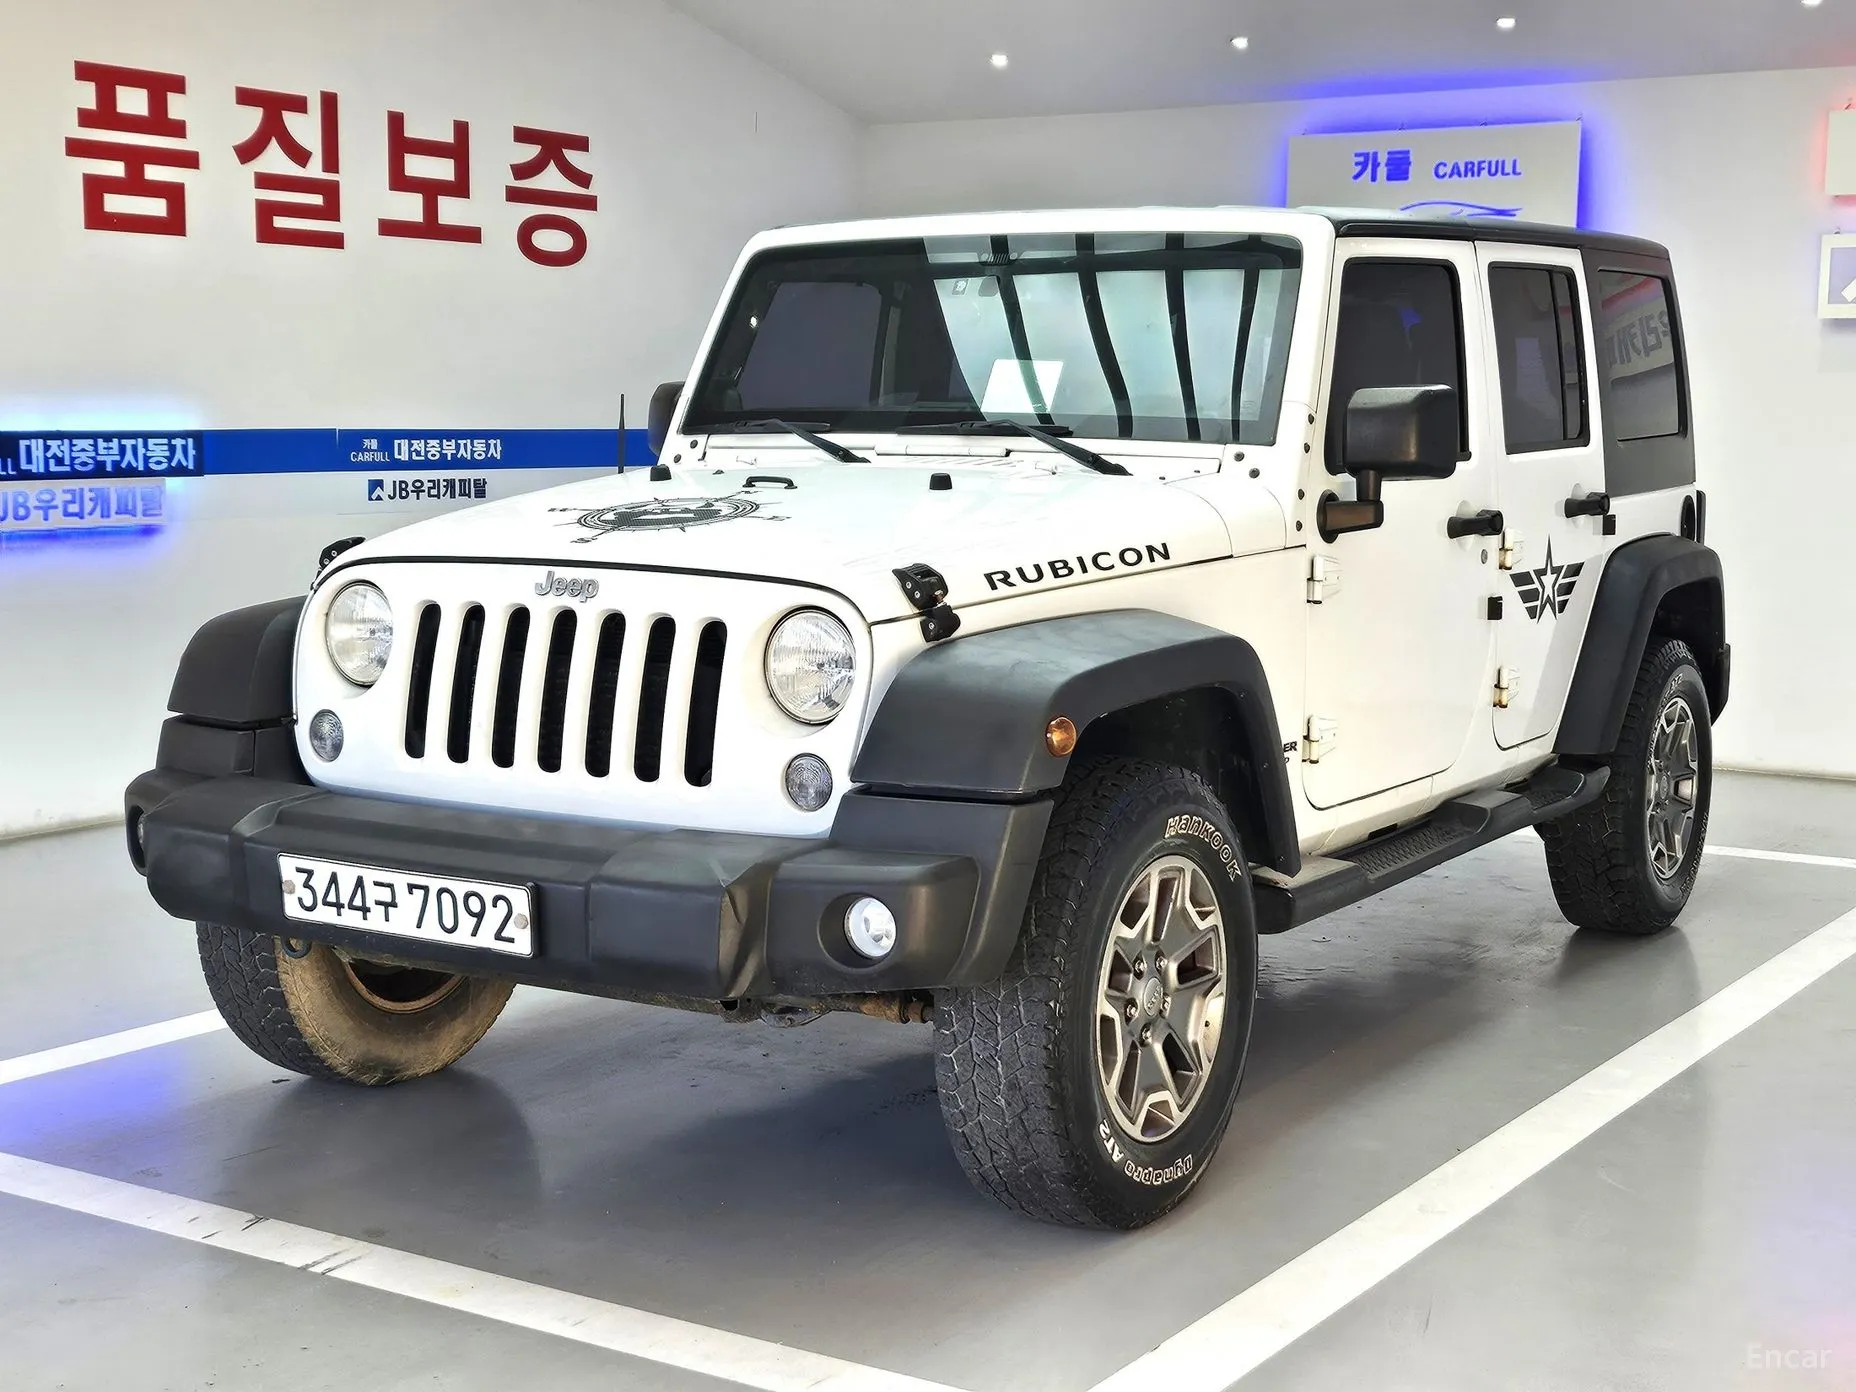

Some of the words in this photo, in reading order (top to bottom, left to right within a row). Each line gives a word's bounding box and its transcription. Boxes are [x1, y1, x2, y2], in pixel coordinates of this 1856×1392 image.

[1433, 158, 1522, 180] CARFULL
[19, 438, 196, 473] 대전중부자동차
[350, 451, 390, 462] CARFULL
[394, 439, 501, 460] 대전중부자동차
[387, 478, 487, 500] JB우리캐피탈
[983, 542, 1171, 590] RUBICON
[534, 570, 600, 603] Jeep
[295, 866, 398, 922] 344구
[407, 882, 515, 943] 7092
[1099, 1119, 1124, 1162] AT2
[1124, 1153, 1193, 1185] Dynapro
